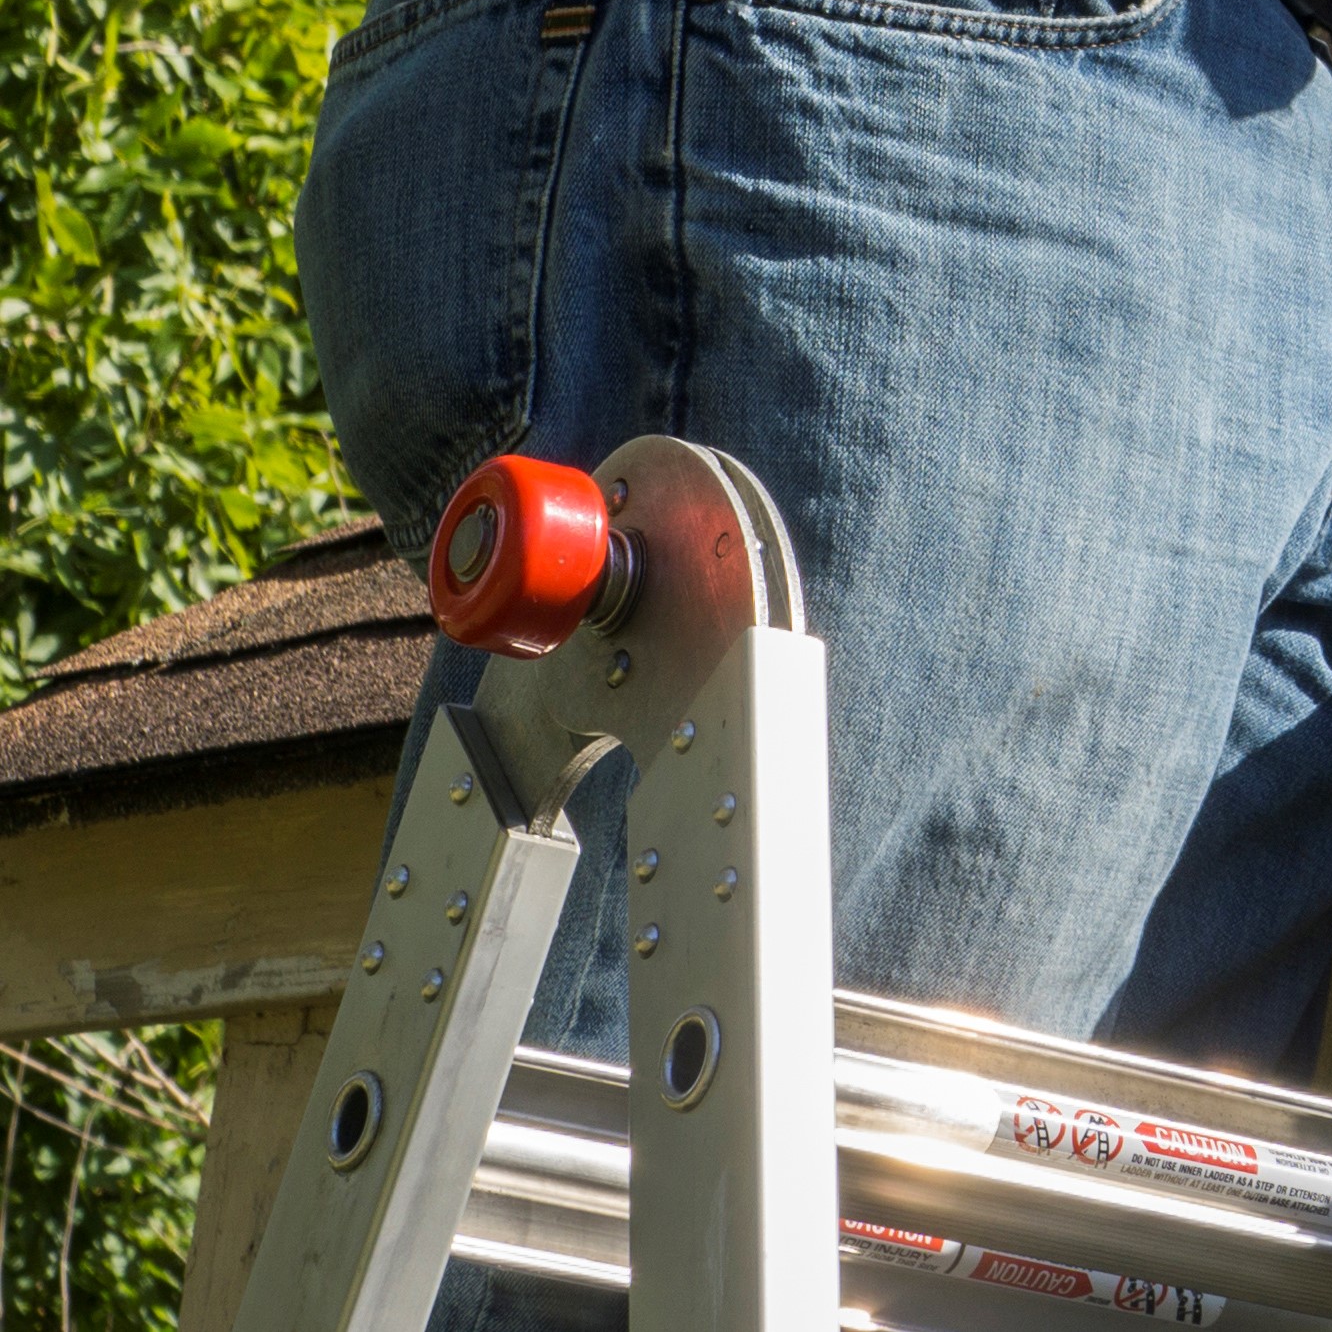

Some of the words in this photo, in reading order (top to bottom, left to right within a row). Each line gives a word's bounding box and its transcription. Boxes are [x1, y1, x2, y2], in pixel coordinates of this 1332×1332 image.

[1154, 1126, 1247, 1165] CAUTION
[1131, 1153, 1143, 1164] DO
[1144, 1156, 1161, 1168] NOT
[1162, 1160, 1178, 1172] USE
[1179, 1164, 1203, 1177] INNER
[1204, 1169, 1235, 1184] LADDER
[1236, 1176, 1247, 1187] AS
[1247, 1178, 1253, 1188] A
[1255, 1180, 1275, 1192] STEP
[1276, 1184, 1288, 1195] OR
[1289, 1187, 1331, 1205] EXTENSION
[1275, 1157, 1317, 1173] EXTENSION
[1120, 1164, 1152, 1178] LADDER
[1153, 1171, 1189, 1186] WITHOUT
[1189, 1179, 1201, 1189] AT
[1201, 1182, 1226, 1194] LEAST
[1226, 1187, 1243, 1198] ONE
[1243, 1191, 1270, 1204] OUTER
[1269, 1196, 1291, 1208] BASE
[873, 1242, 933, 1262] INJURY
[985, 1259, 1077, 1295] CAUTION
